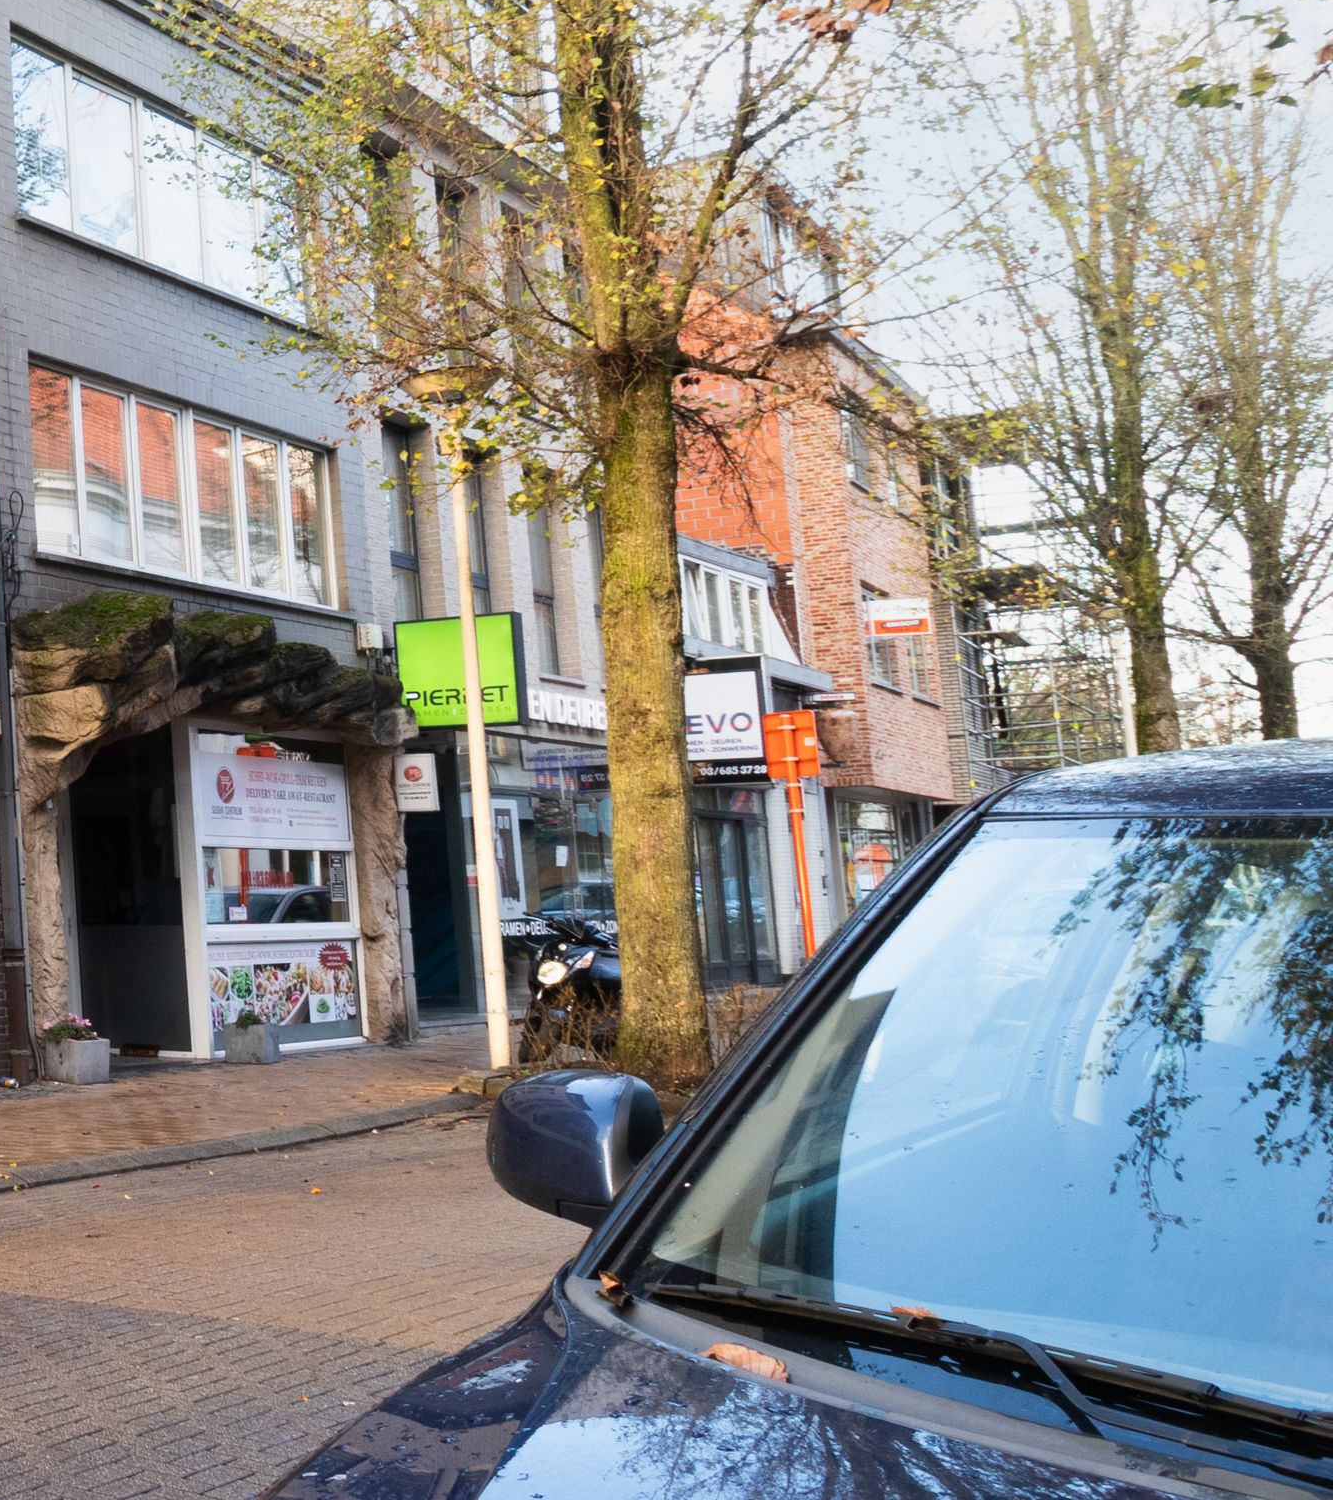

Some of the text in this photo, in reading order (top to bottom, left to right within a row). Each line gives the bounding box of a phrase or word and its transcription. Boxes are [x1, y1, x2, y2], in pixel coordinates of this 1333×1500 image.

[405, 685, 509, 706] PIERET
[552, 692, 608, 731] DEURE
[712, 745, 759, 753] ZONWERING
[700, 765, 767, 776] 03/685 37 28
